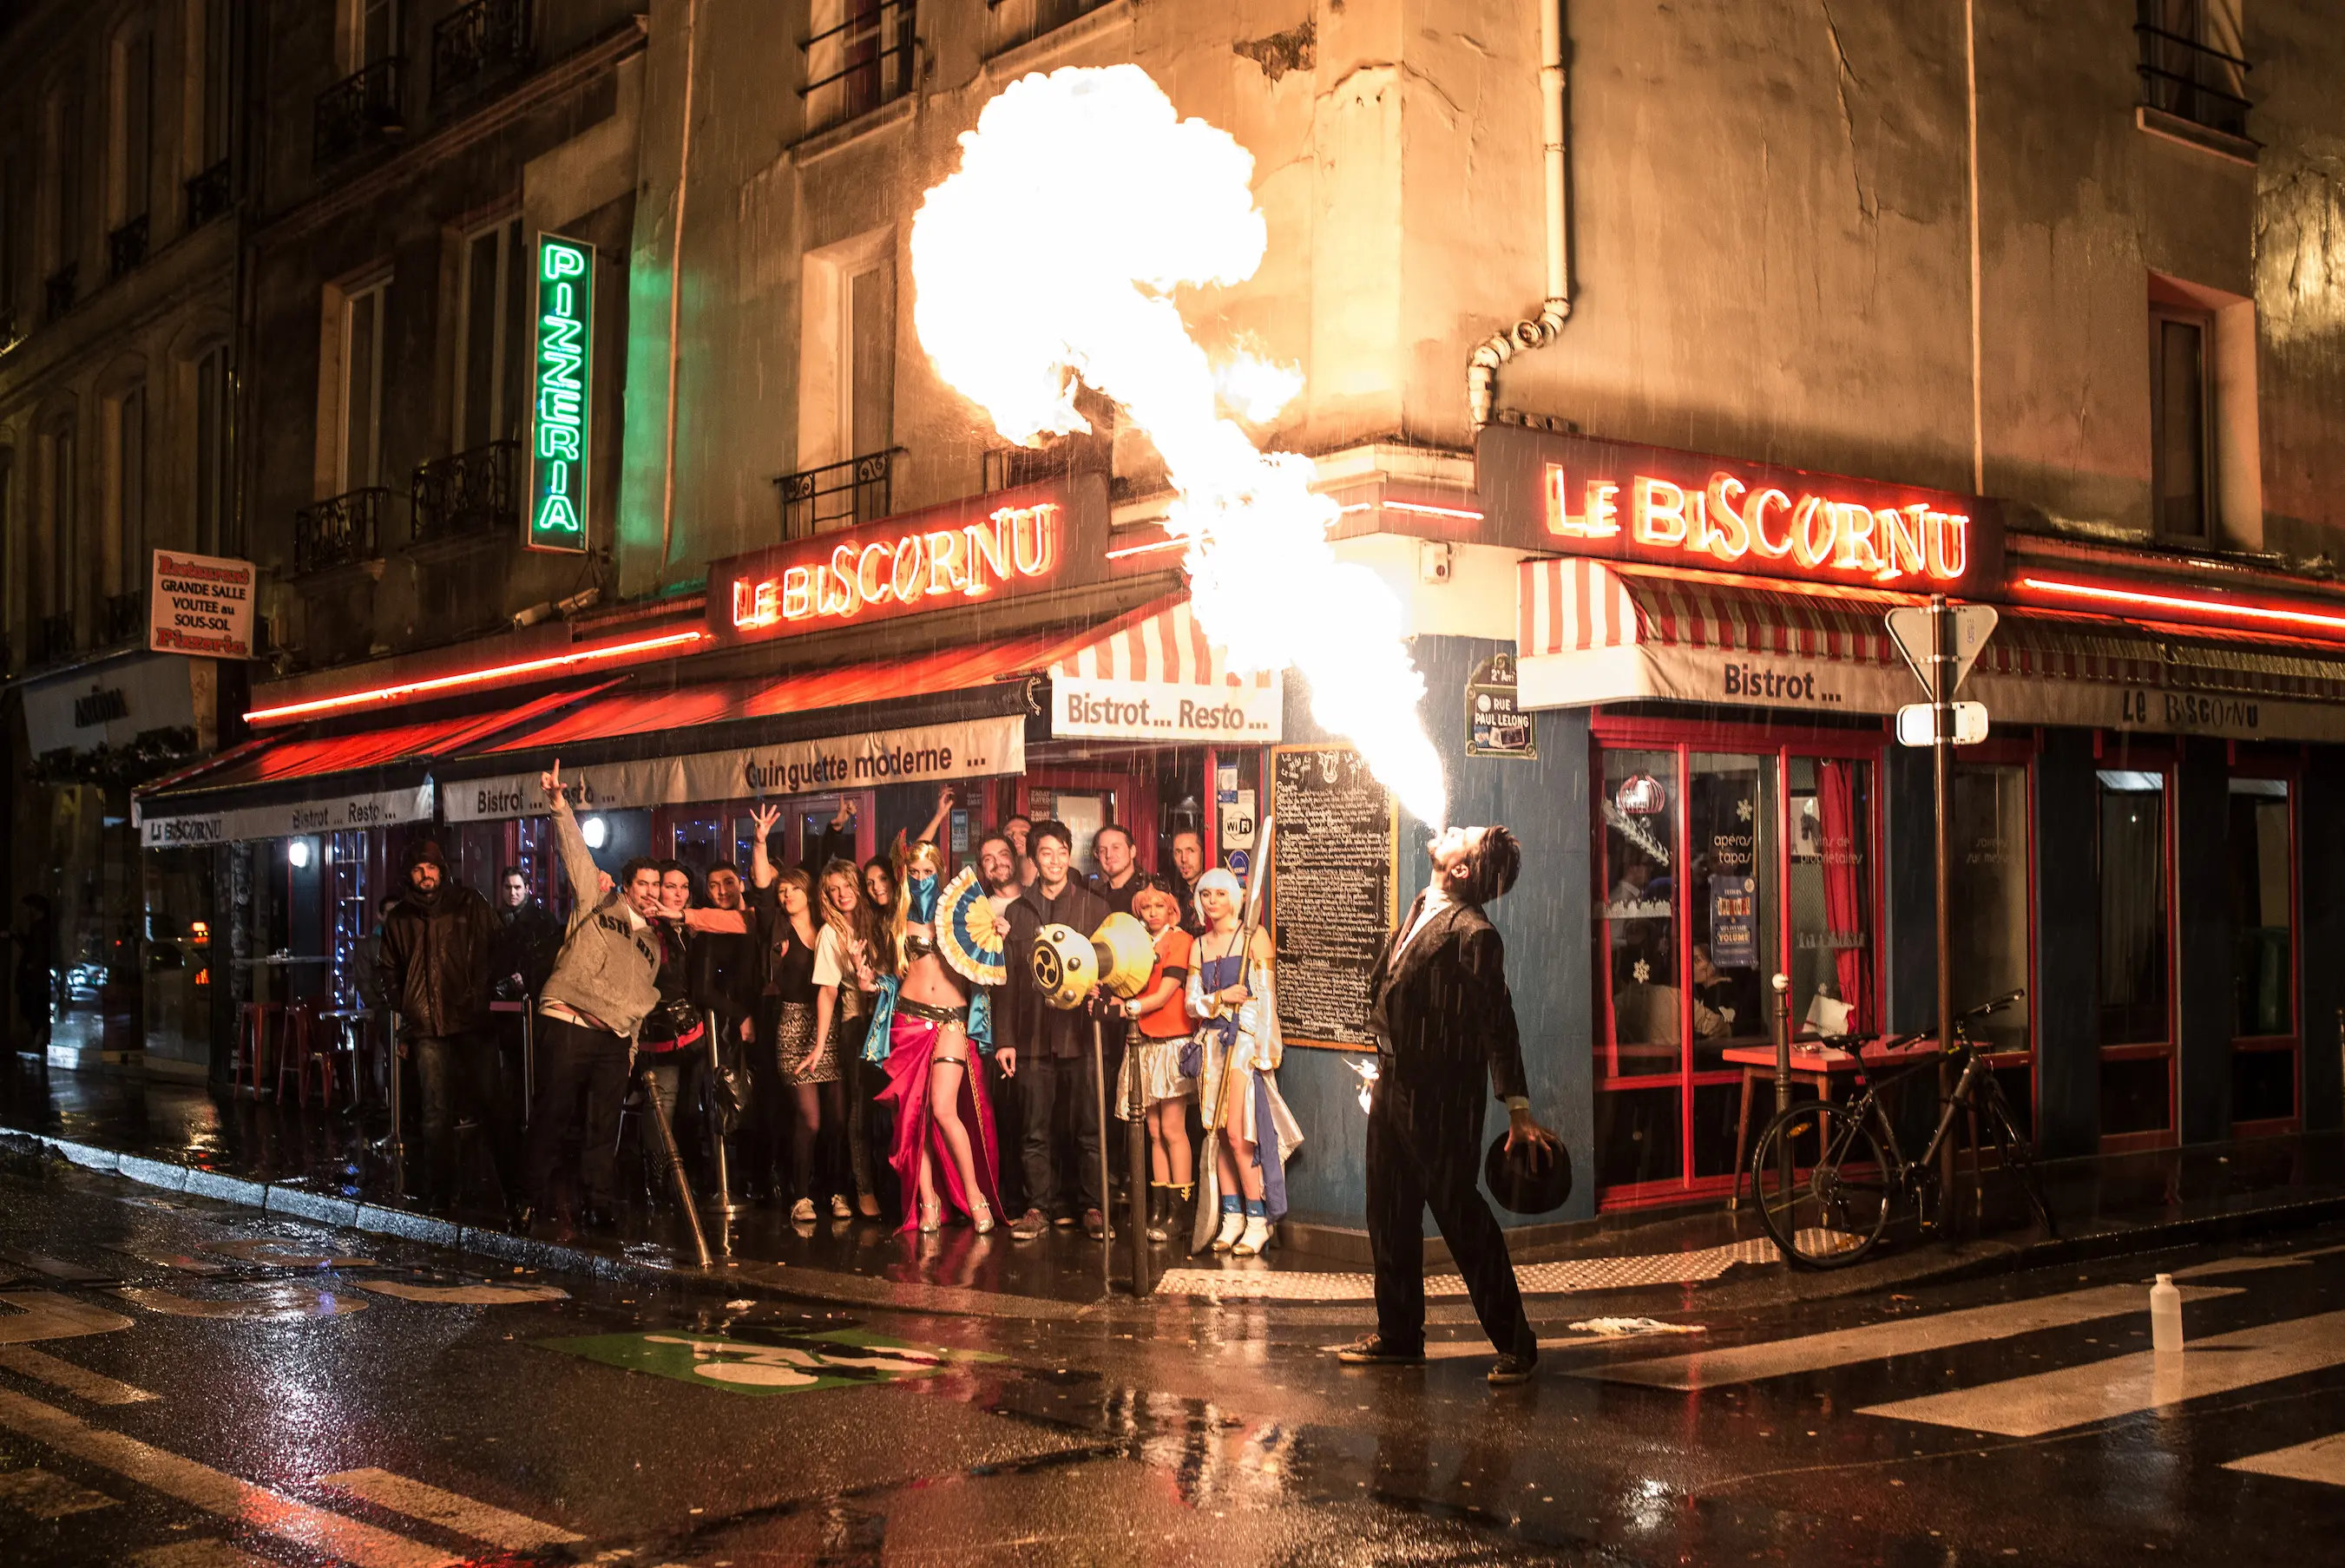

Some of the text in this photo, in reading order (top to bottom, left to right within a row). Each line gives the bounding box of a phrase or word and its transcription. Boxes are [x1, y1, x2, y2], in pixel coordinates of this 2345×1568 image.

[539, 244, 585, 531] PIZZERIA
[1546, 463, 1970, 581] LE BISCORNU
[158, 555, 250, 586] Restaurant
[732, 502, 1060, 632] LE BISCORNU
[161, 579, 246, 600] GRANDE SALLE
[172, 596, 235, 615] VOUTEE au
[174, 613, 232, 632] SOUS-SOL
[156, 627, 248, 654] Pizzeria
[1724, 663, 1815, 700] Bistrot
[1494, 698, 1511, 712] RUE
[1475, 712, 1529, 728] PAUL LELONG
[745, 754, 848, 791] Guinguette
[855, 745, 952, 778] moderne
[348, 802, 380, 823] Resto
[165, 818, 221, 841] BSCORNU
[1836, 836, 1850, 848] de
[1718, 852, 1752, 865] tapas
